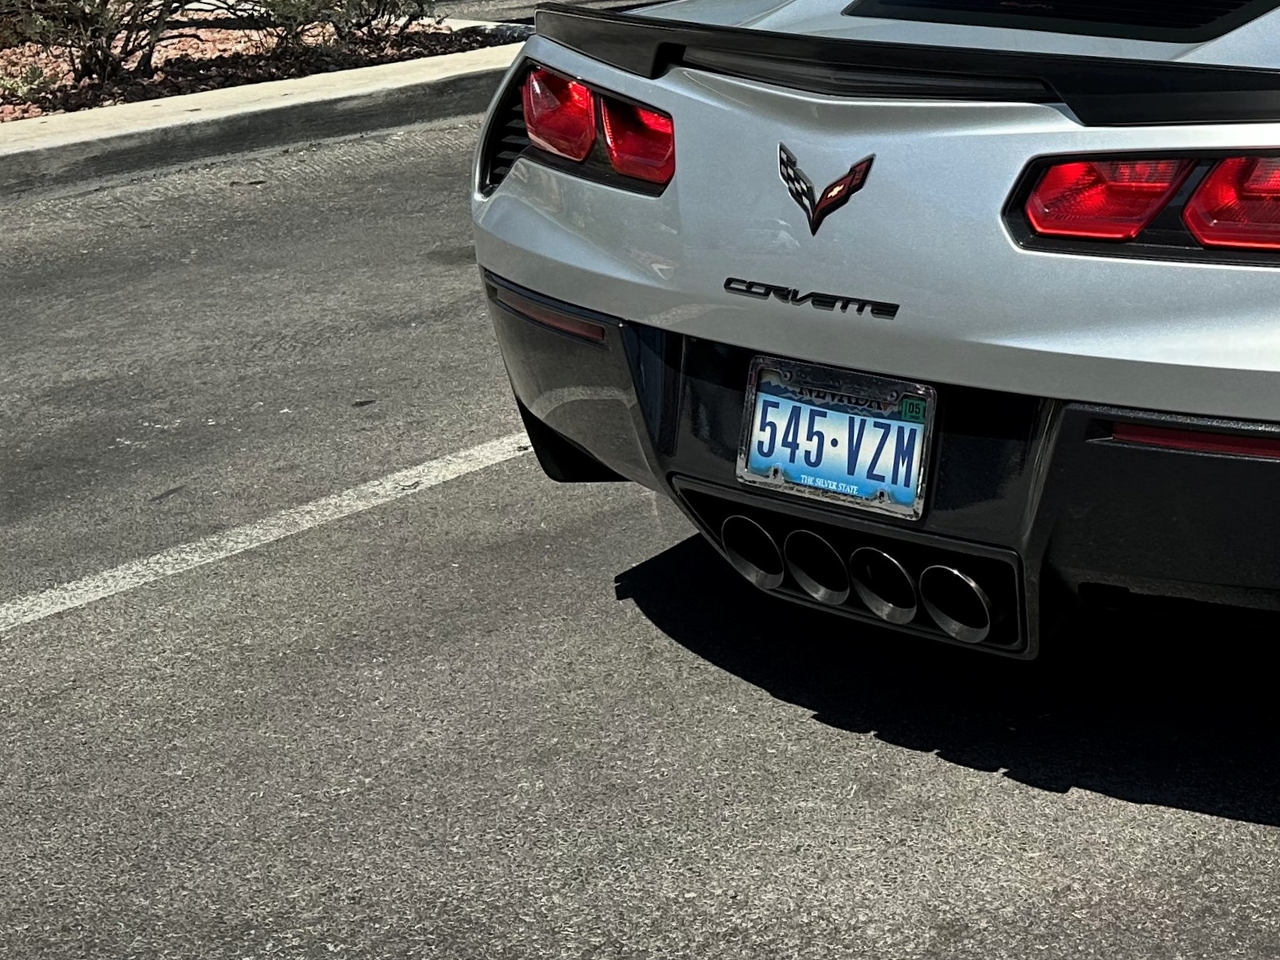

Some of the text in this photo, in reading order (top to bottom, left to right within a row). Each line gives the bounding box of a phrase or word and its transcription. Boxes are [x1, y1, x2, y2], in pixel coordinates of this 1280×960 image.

[724, 277, 900, 320] CORVETTE
[907, 401, 921, 415] 05
[801, 474, 859, 495] THE SILVER STATE
